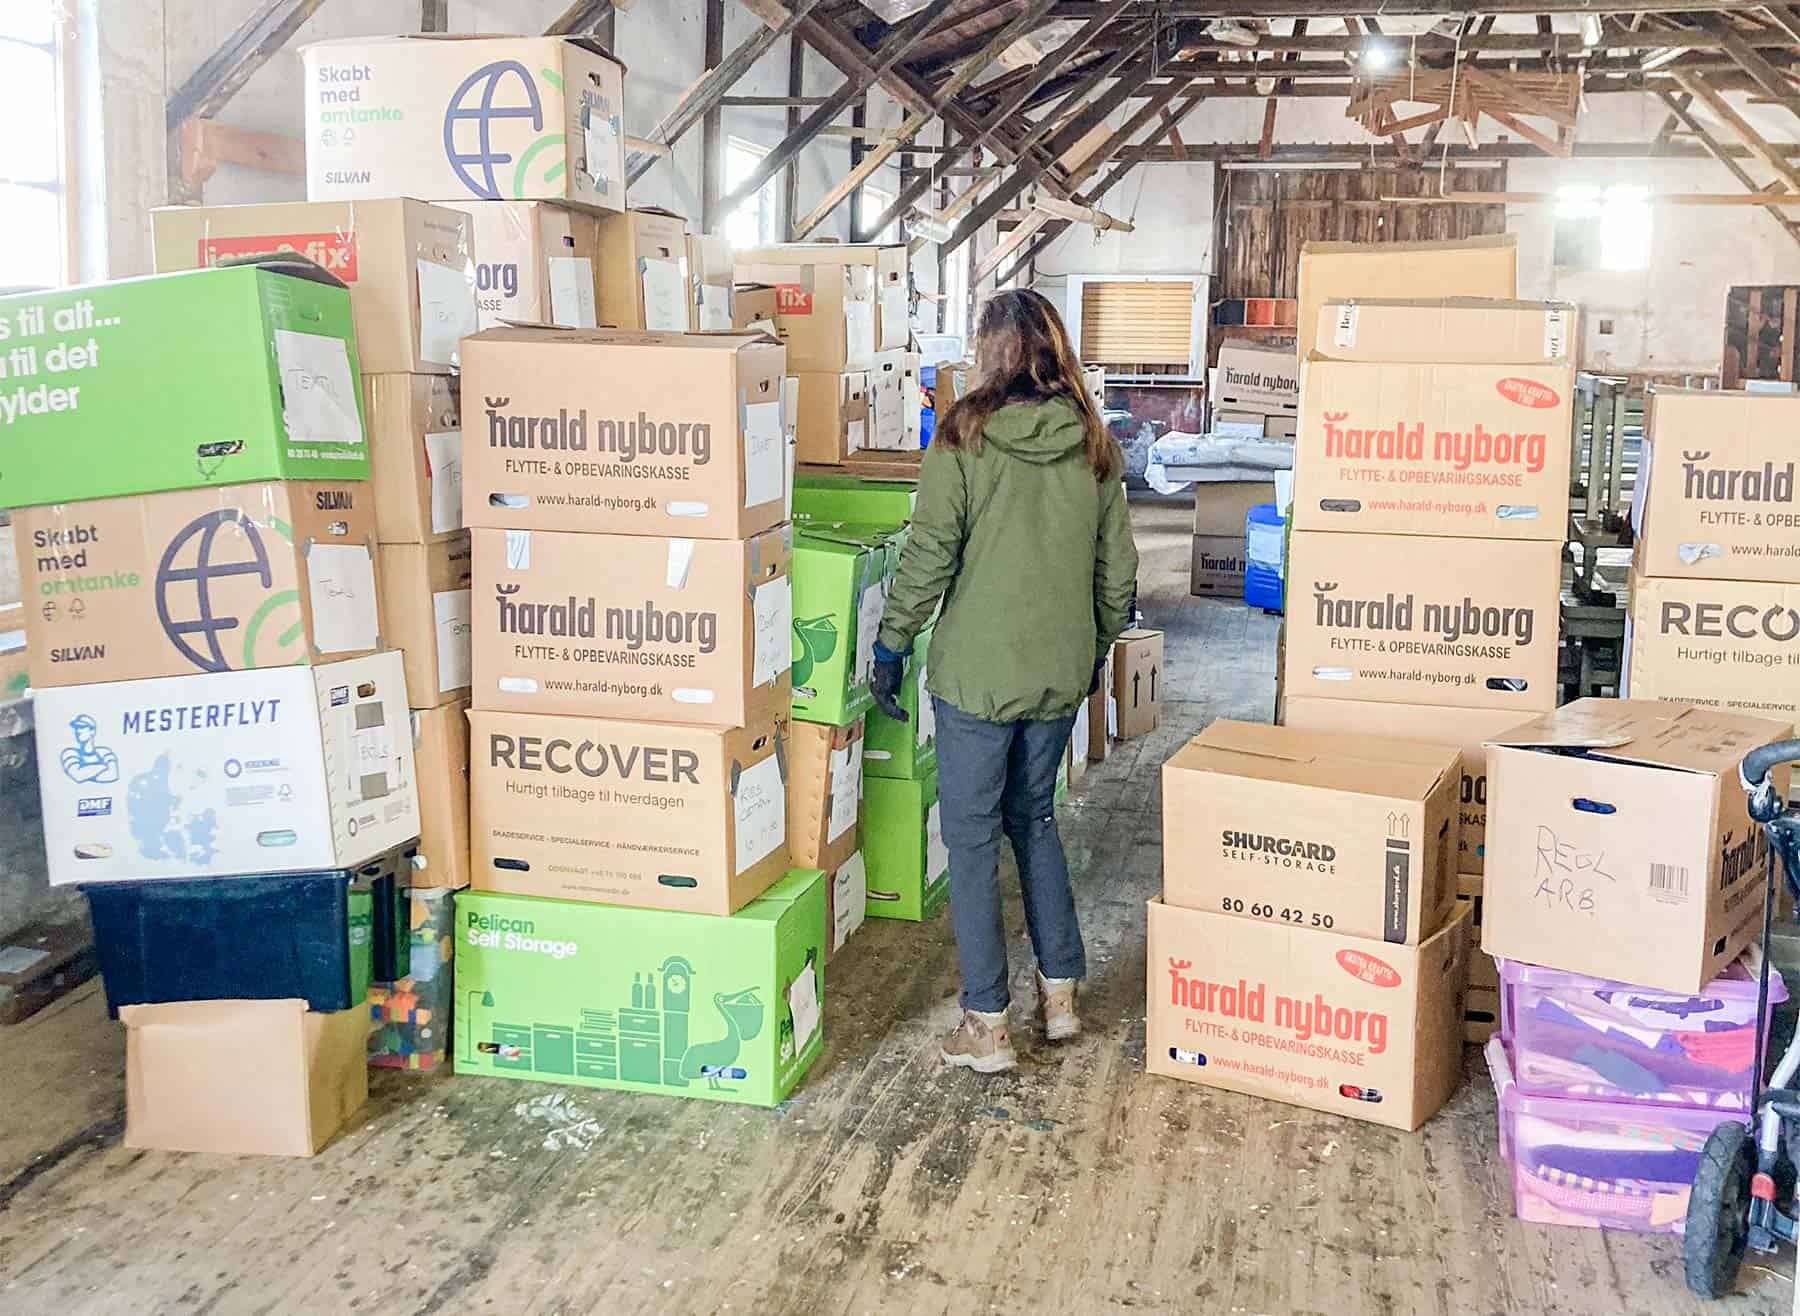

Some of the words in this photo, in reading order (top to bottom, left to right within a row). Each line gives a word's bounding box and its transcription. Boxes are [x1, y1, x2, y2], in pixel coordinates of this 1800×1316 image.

[319, 65, 371, 83] Skabt
[320, 86, 361, 104] med
[320, 106, 404, 123] omtanke
[325, 171, 371, 184] SILVAN
[17, 305, 45, 336] til
[9, 346, 38, 376] til
[45, 338, 98, 372] det
[0, 384, 80, 424] ylder
[485, 407, 587, 451] harald
[598, 411, 711, 465] nyborg
[1323, 420, 1425, 460] harald
[1433, 424, 1547, 472] nyborg
[505, 459, 552, 475] FLYTTE-
[554, 462, 562, 475] &
[565, 461, 690, 480] OPBEVARINGSKASSE
[1340, 467, 1385, 482] FLYTTE-
[1387, 470, 1396, 482] &
[1399, 470, 1523, 486] OPBEVARINGSKASSE
[1682, 461, 1795, 502] harald
[316, 491, 353, 510] SILVAN
[537, 494, 657, 511] www.harald-nyborg.dk
[1368, 498, 1488, 514] www.harald-nyborg.dk
[1700, 511, 1750, 526] FLYTTE-
[1753, 513, 1762, 526] &
[34, 525, 99, 548] Skabt
[37, 549, 87, 572] med
[41, 571, 140, 595] omtanke
[496, 595, 595, 638] harald
[606, 601, 717, 653] nyborg
[1313, 592, 1413, 631] harald
[1424, 597, 1534, 646] nyborg
[1660, 601, 1800, 642] RECO
[50, 645, 105, 662] SILVAN
[515, 645, 560, 661] FLYTTE-
[562, 648, 569, 661] &
[573, 648, 696, 668] OPBEVARINGSKASSE
[1330, 637, 1376, 652] FLYTTE-
[1378, 640, 1386, 652] &
[1389, 640, 1511, 659] OPBEVARINGSKASSE
[1677, 647, 1727, 664] Hurtigt
[1733, 649, 1782, 667] tilbage
[545, 679, 663, 697] www.harald-nyborg.dk
[1359, 667, 1477, 686] www.harald-nyborg.dk
[123, 698, 281, 735] MESTERFLYT
[1727, 700, 1797, 712] SPECIALSERVICE
[490, 733, 701, 785] RECOVER
[506, 781, 549, 797] Hurtigt
[552, 786, 596, 803] tilbage
[599, 790, 610, 801] til
[614, 790, 685, 810] hverdagen
[551, 836, 611, 849] SPECIALSERVICE
[1222, 830, 1336, 862] SHURGARD
[467, 911, 535, 934] Pelican
[1222, 897, 1244, 912] 80
[1251, 903, 1273, 918] 60
[1280, 908, 1304, 923] 42
[1311, 913, 1334, 929] 50
[467, 928, 500, 948] Self
[504, 932, 577, 959] Storage
[1168, 969, 1265, 1023] harald
[1275, 995, 1388, 1054] nyborg
[1185, 1018, 1229, 1040] FLYTTE-
[1231, 1028, 1239, 1041] &
[1242, 1031, 1365, 1066] OPBEVARINGSKASSE
[1213, 1055, 1329, 1089] www.harald-nyborg.dk
